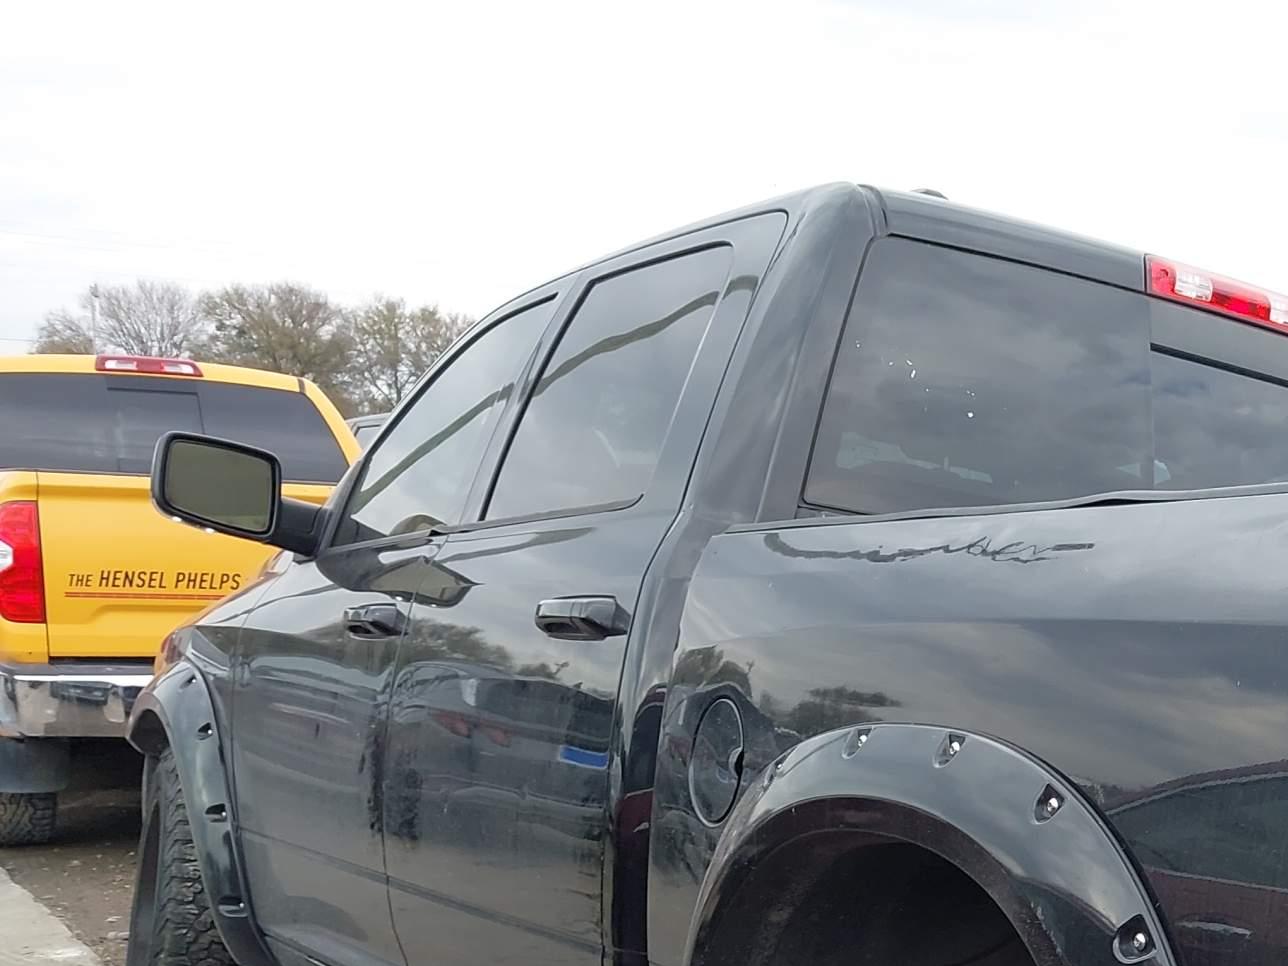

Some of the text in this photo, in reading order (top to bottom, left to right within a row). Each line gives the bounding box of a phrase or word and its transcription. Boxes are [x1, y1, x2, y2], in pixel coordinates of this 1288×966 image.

[68, 570, 242, 590] THE HENSEL PHELPS
